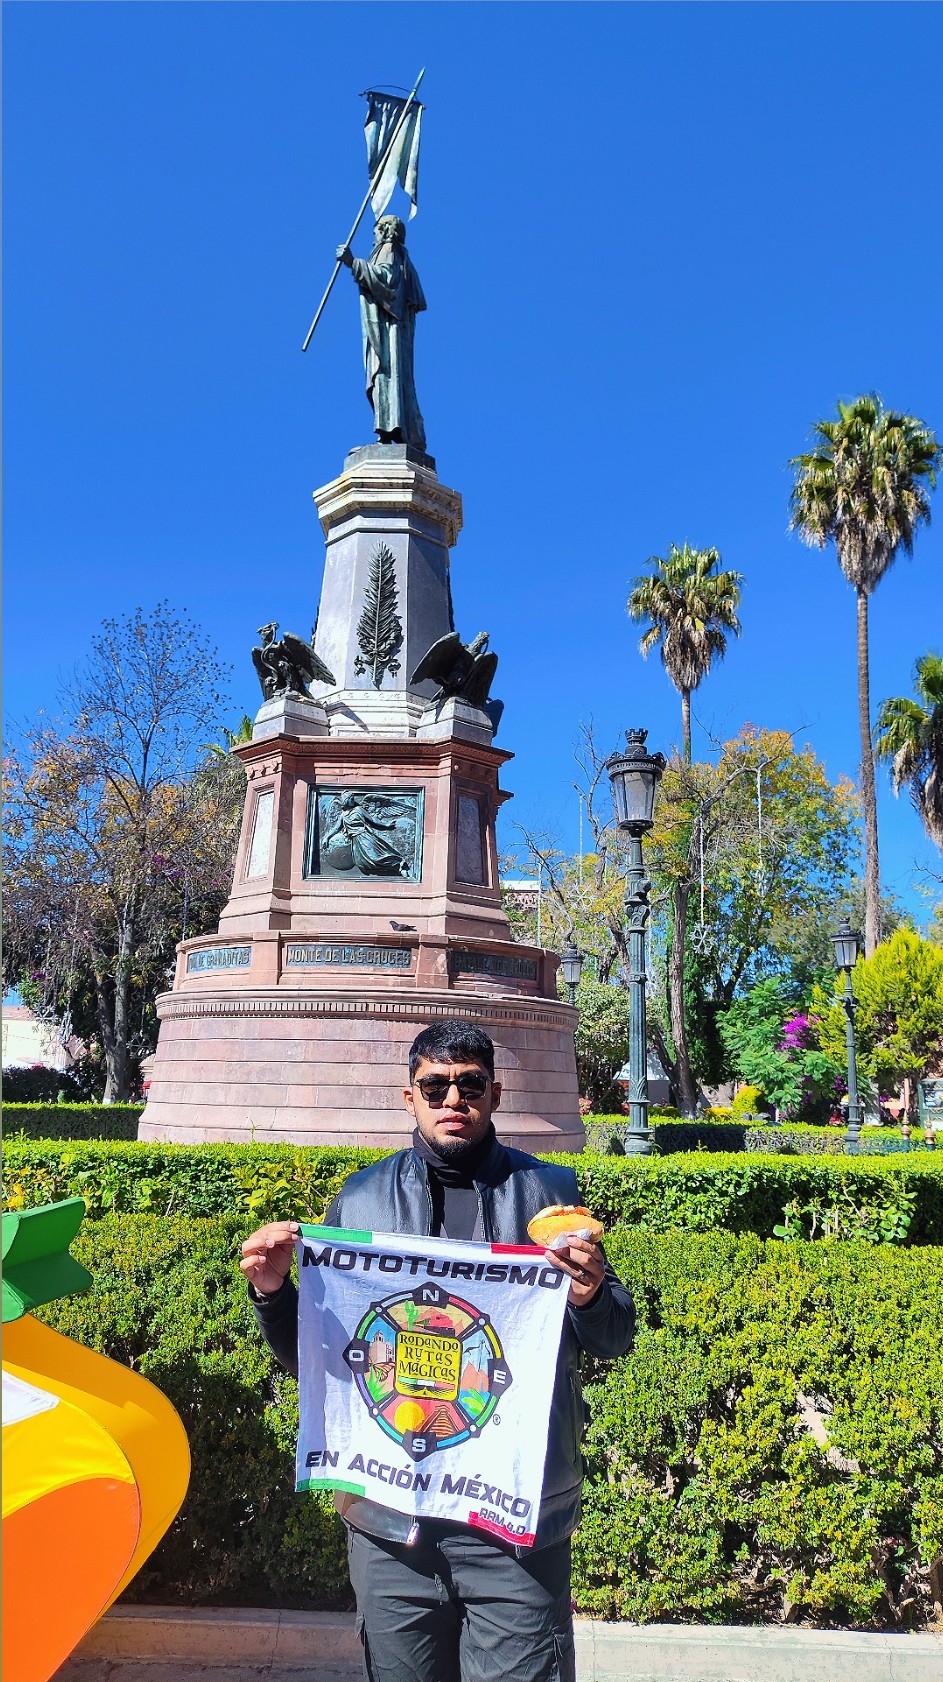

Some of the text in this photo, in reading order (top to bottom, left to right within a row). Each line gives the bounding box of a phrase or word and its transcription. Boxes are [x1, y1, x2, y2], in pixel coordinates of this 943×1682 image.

[287, 949, 411, 965] MONTE DE LAS CRUCES
[302, 1246, 564, 1289] MOTOTURISMO
[422, 1289, 440, 1302] N
[348, 1350, 365, 1362] O
[493, 1369, 507, 1385] E
[411, 1438, 427, 1453] S
[305, 1450, 531, 1518] EN ACCIÓN MÉXICO
[479, 1507, 526, 1536] RRM 4.0
